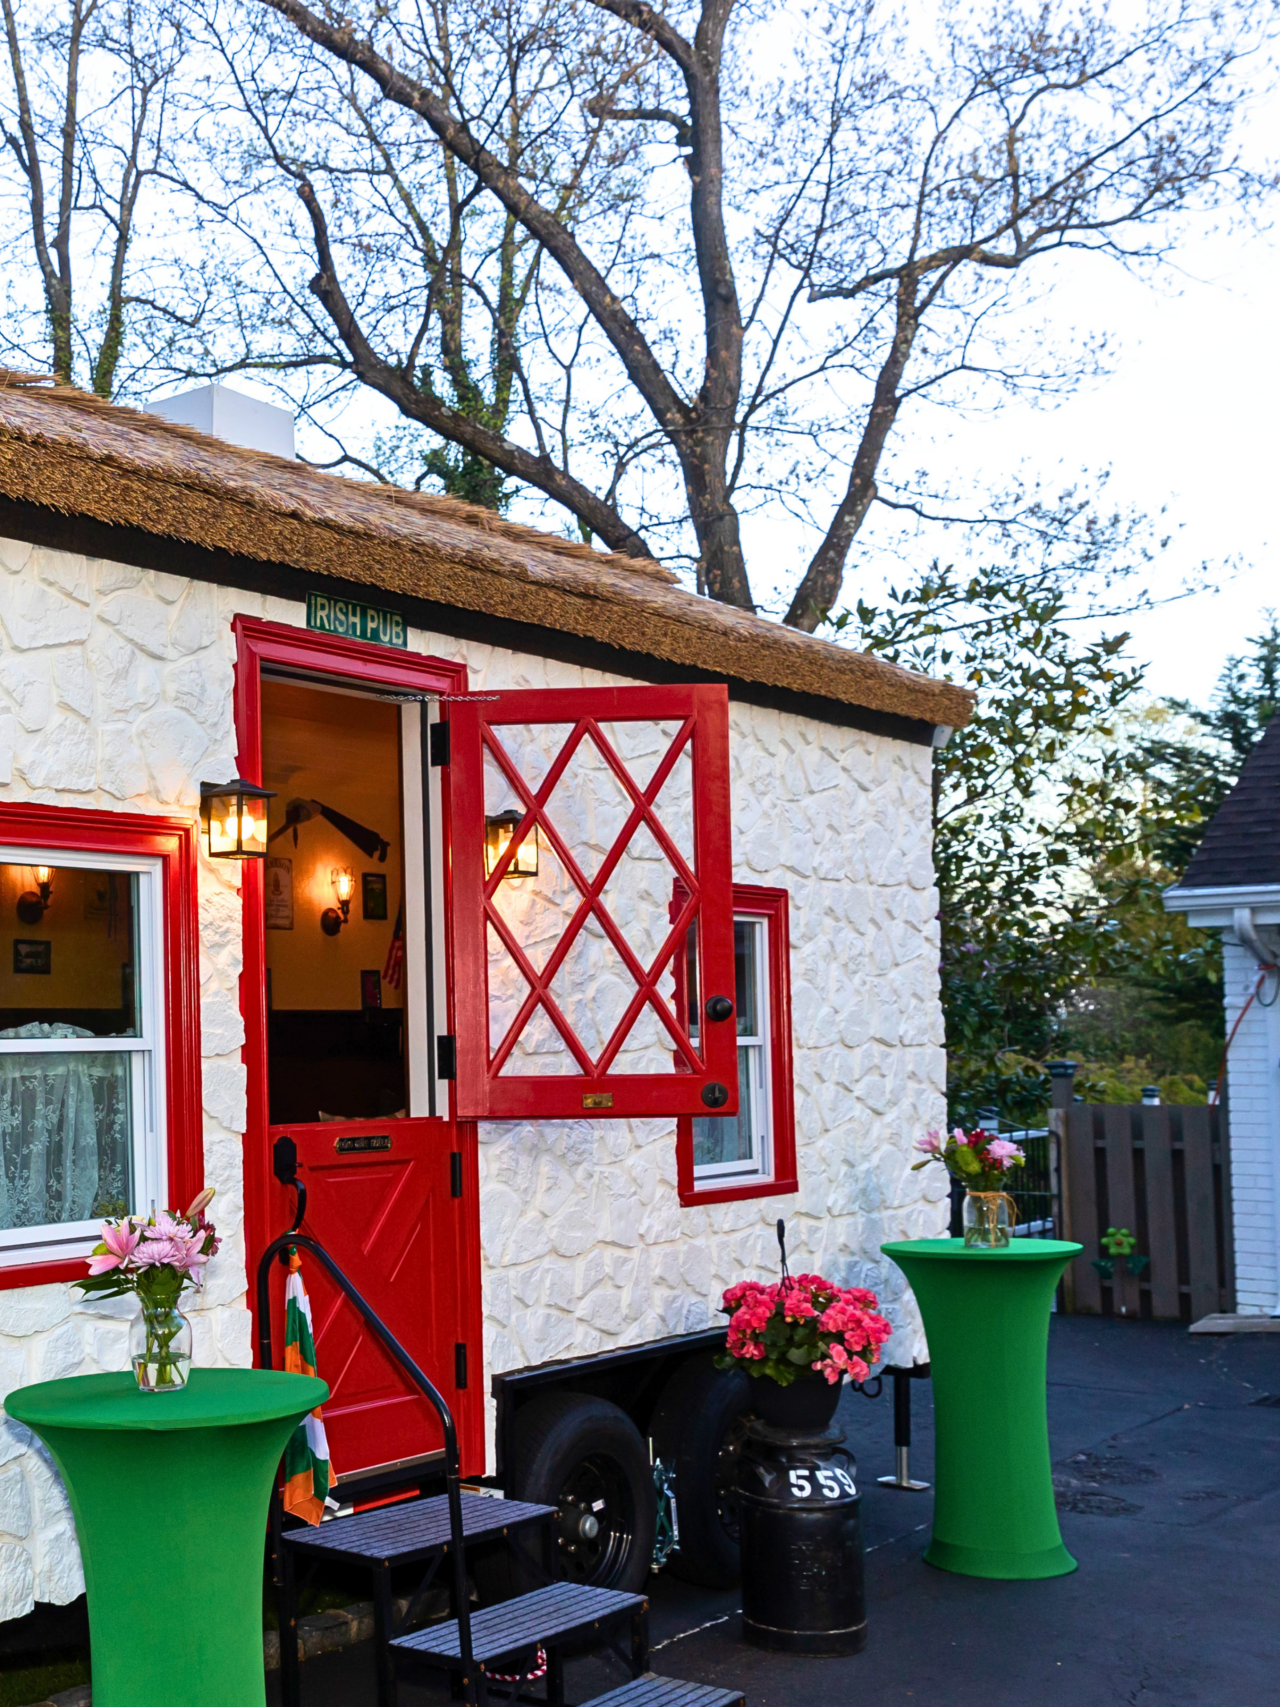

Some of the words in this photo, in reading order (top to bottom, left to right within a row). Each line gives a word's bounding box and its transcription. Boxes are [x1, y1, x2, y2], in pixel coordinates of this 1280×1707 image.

[310, 595, 360, 636] IRISH
[366, 608, 404, 645] PUB
[789, 1467, 857, 1499] 559
